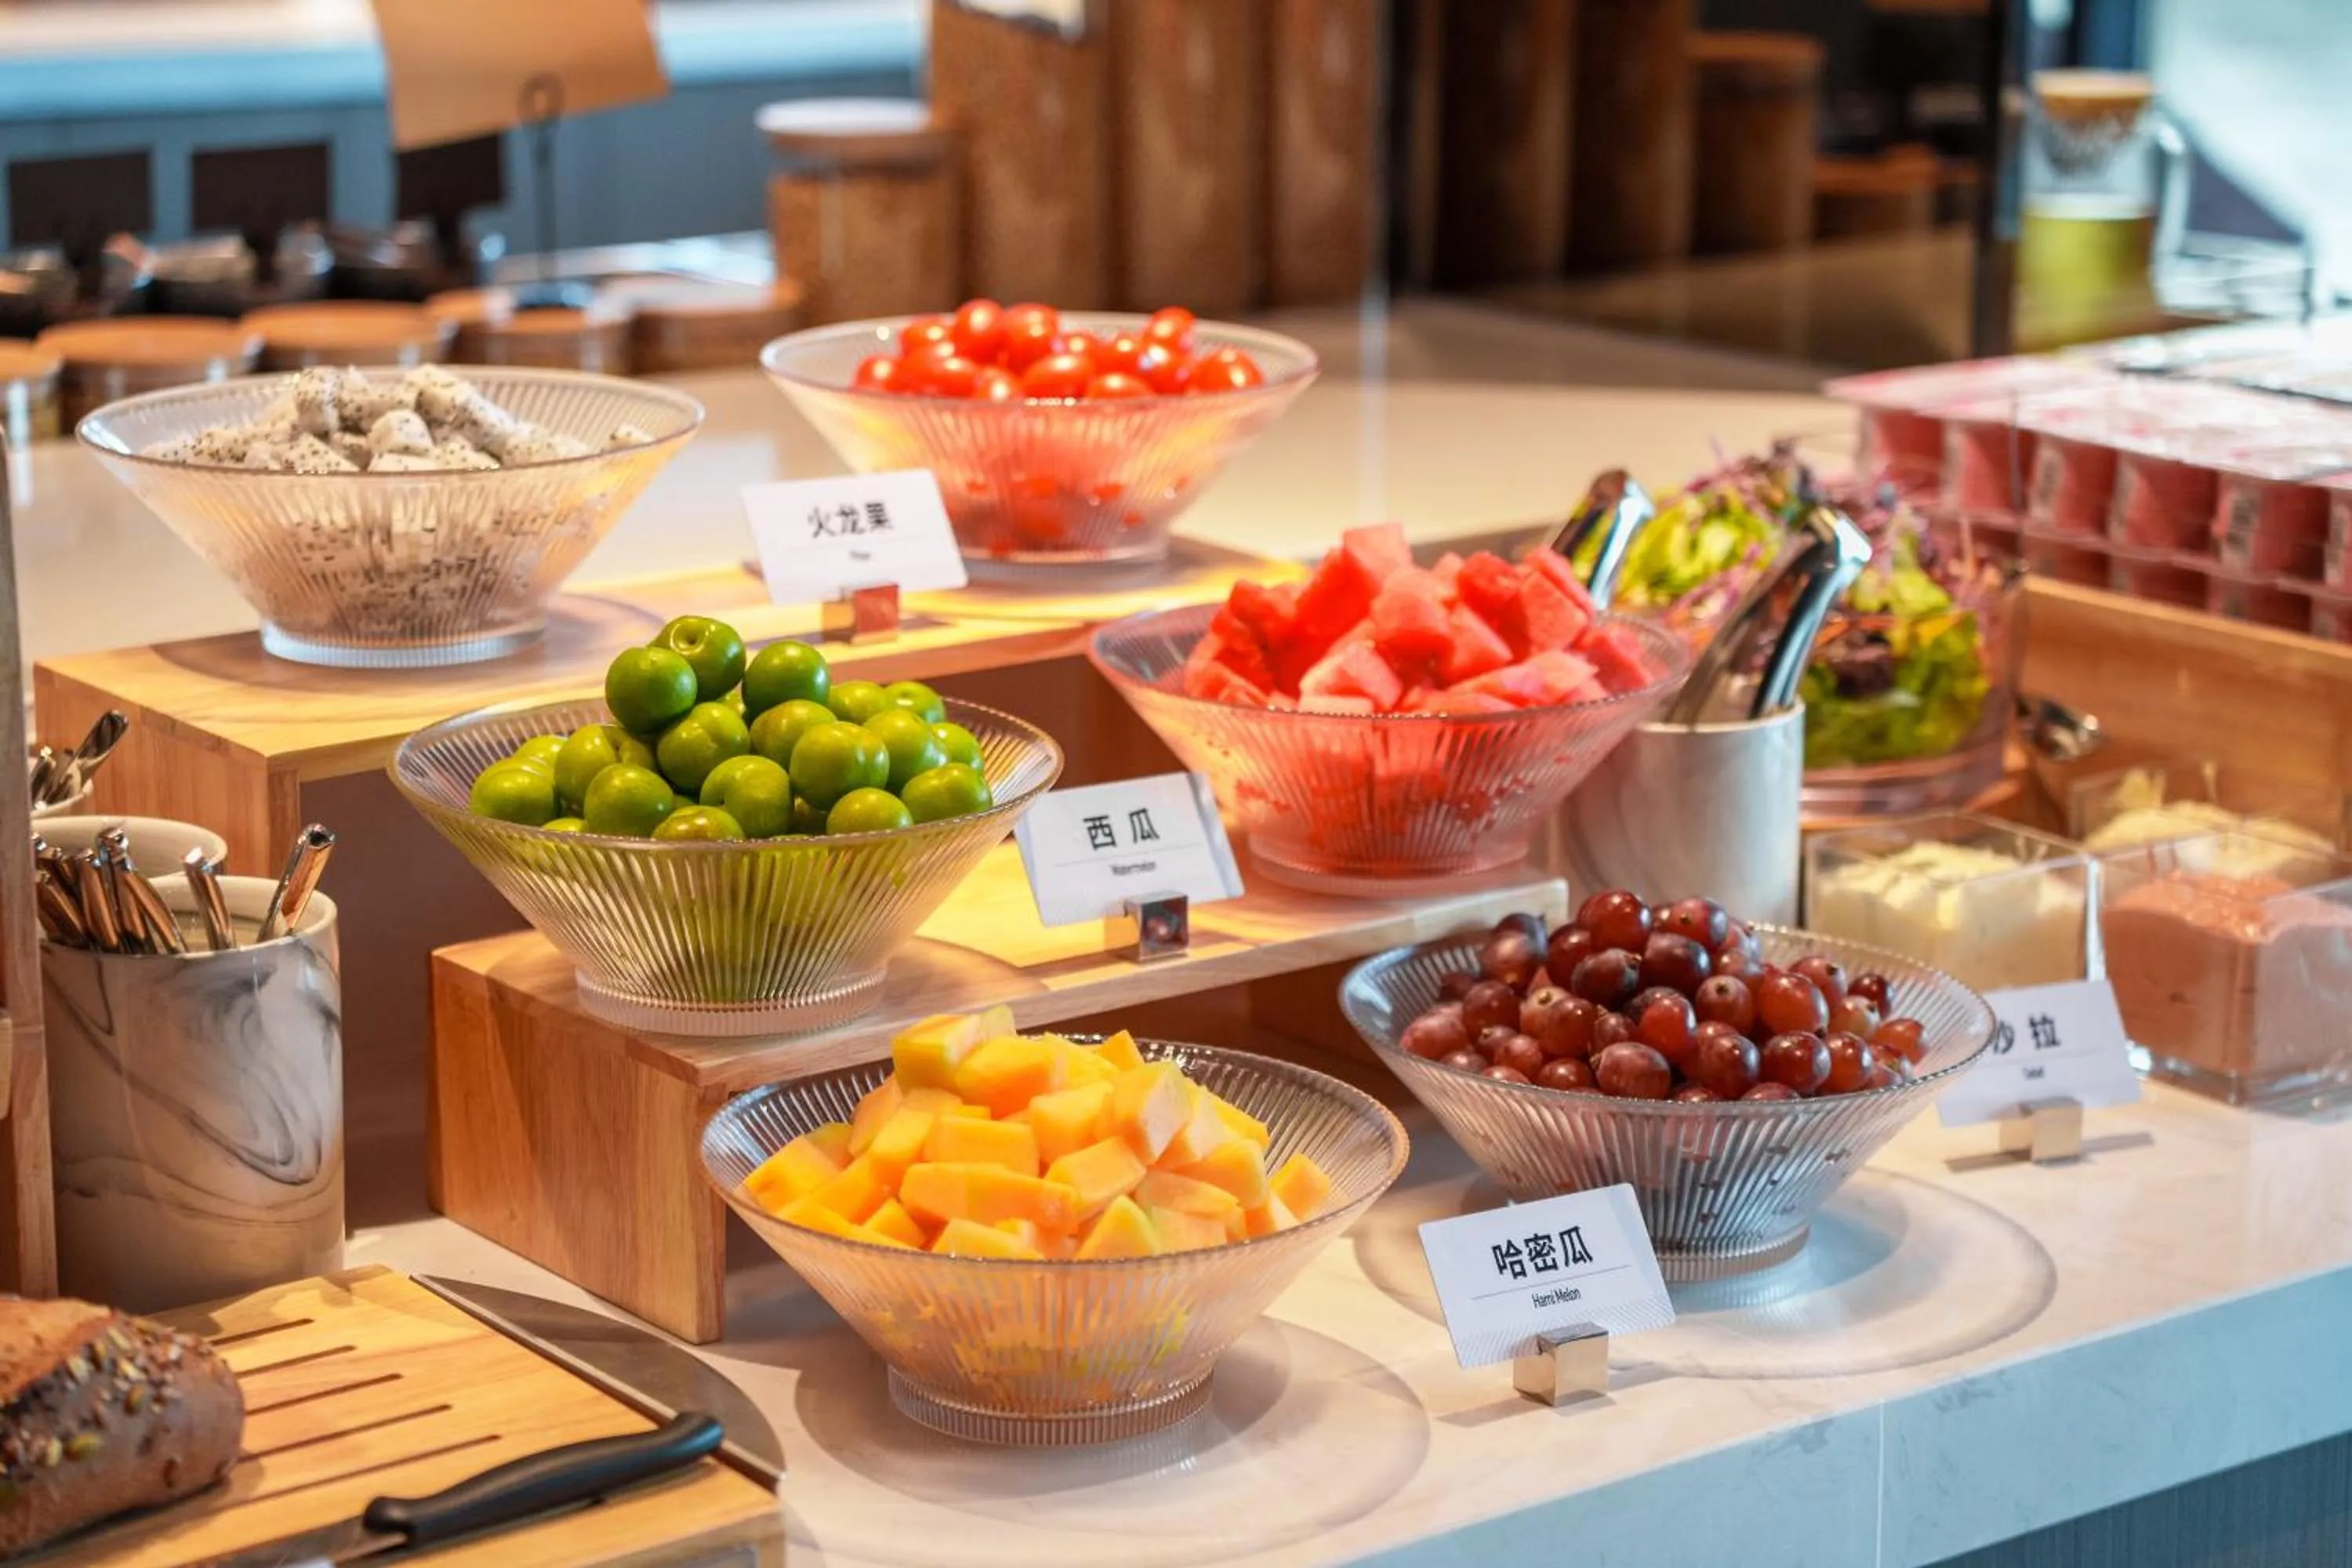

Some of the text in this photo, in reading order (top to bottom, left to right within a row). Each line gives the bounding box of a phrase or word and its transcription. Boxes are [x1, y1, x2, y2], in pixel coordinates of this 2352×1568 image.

[808, 502, 893, 539] 火龙果
[1083, 808, 1160, 851] 西瓜
[1492, 1225, 1593, 1279] 哈密瓜
[1531, 1287, 1581, 1309] Hami Melon
